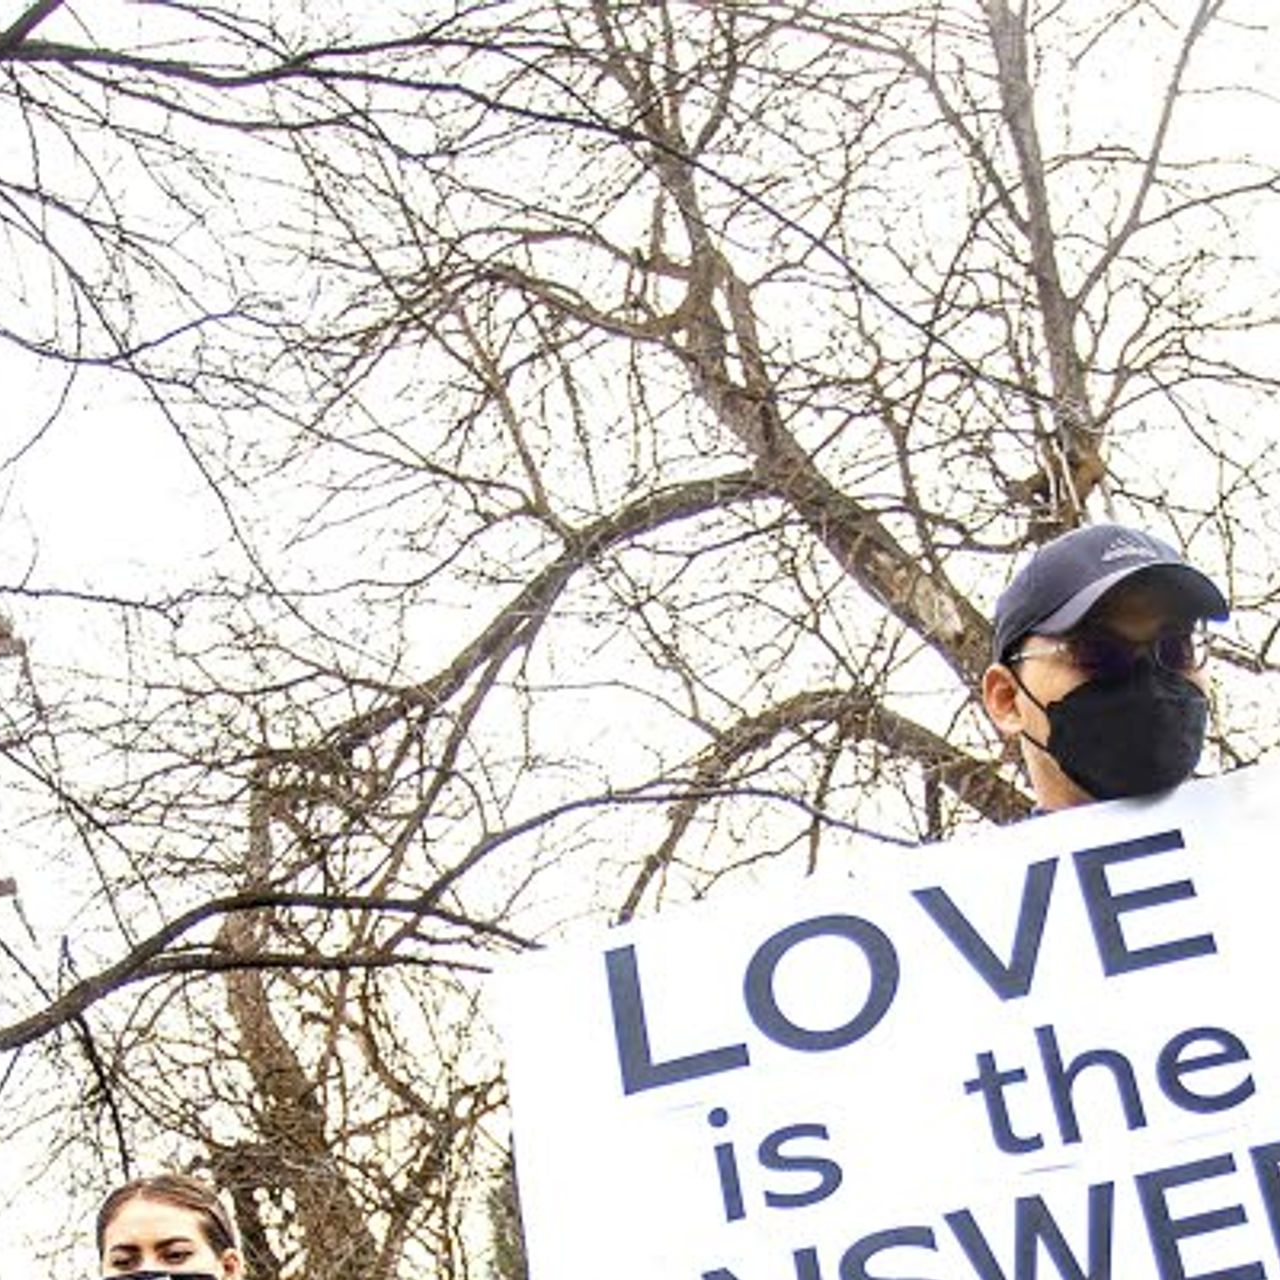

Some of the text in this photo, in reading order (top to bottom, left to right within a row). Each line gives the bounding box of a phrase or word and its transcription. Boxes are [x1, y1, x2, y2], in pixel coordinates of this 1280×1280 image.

[604, 828, 1219, 1097] LOVE
[706, 1023, 1257, 1223] is the
